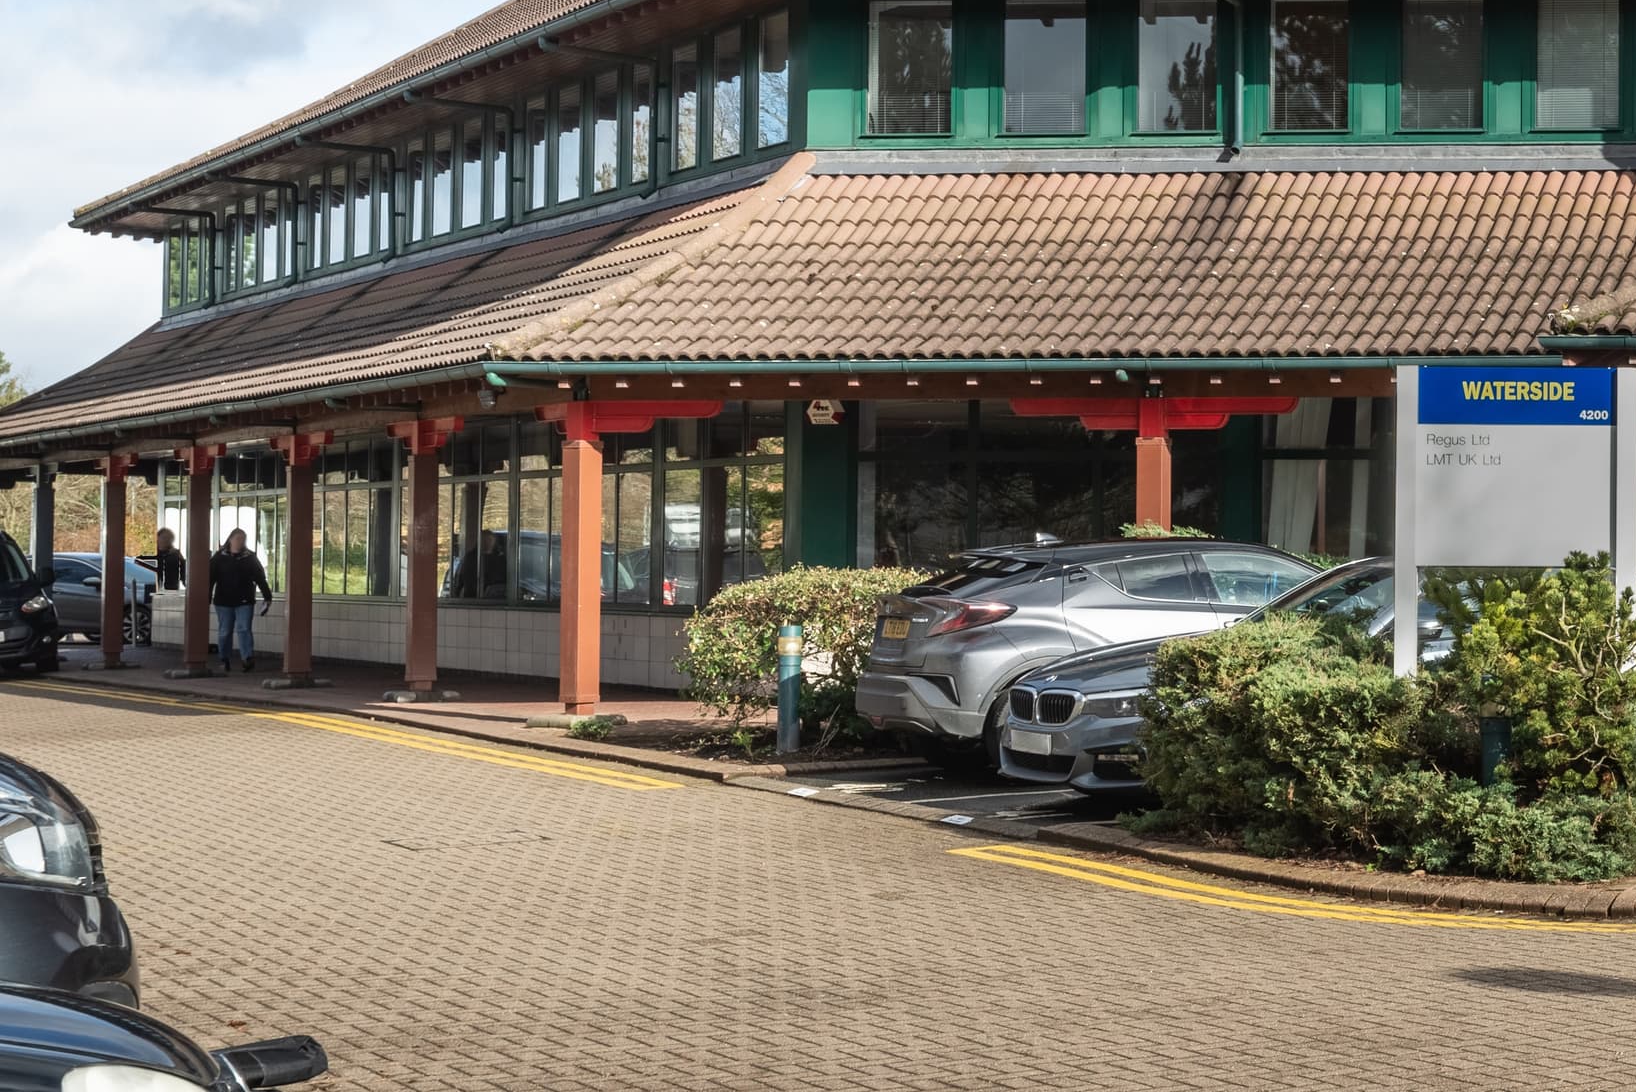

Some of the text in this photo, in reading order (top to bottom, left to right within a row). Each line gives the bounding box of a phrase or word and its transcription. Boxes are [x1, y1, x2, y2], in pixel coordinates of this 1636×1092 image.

[1462, 381, 1575, 401] WATERSIDE
[1579, 410, 1609, 421] 4200
[1426, 434, 1490, 448] Regus Ltd
[1426, 454, 1502, 466] LMT UK Ltd
